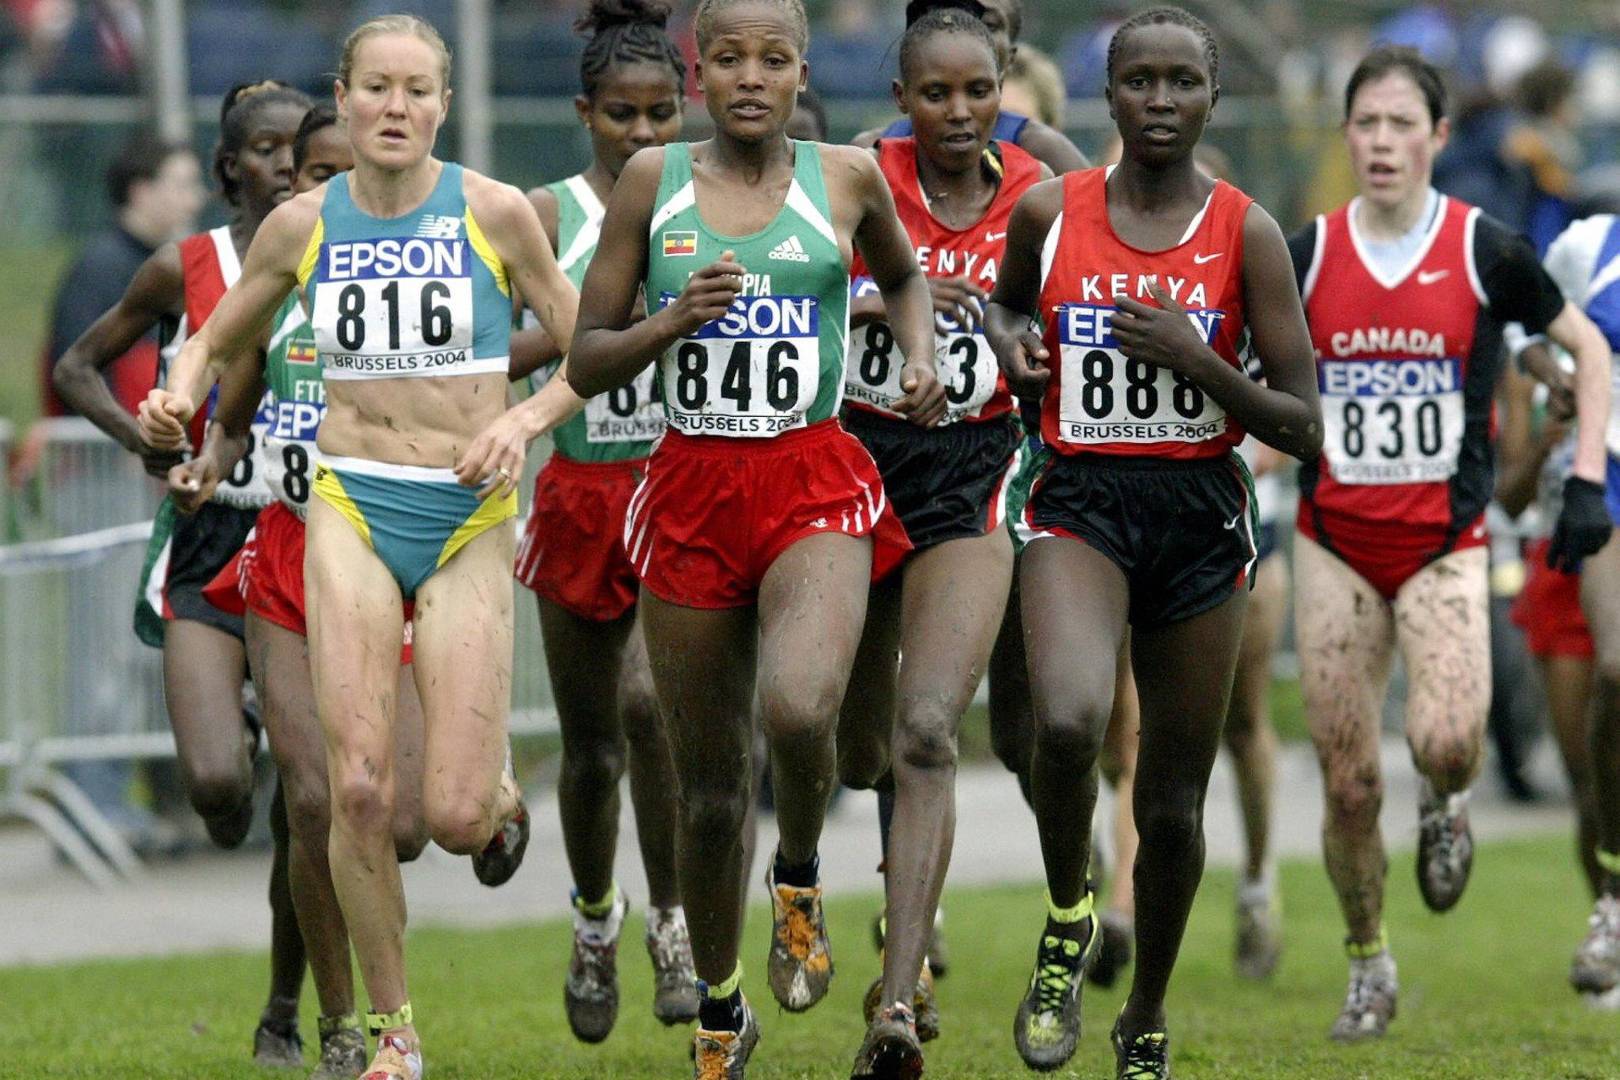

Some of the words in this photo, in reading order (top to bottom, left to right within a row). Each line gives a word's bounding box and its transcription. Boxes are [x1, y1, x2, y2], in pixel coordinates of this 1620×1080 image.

[329, 239, 463, 279] EPSON
[768, 250, 810, 263] adidas
[915, 246, 998, 282] ENYA
[1081, 273, 1207, 308] KENYA
[336, 280, 453, 351] 816
[668, 297, 810, 336] SON
[1068, 306, 1215, 344] EPN
[334, 353, 417, 371] BRUSSELS
[424, 350, 466, 367] 2004
[1331, 327, 1446, 358] CANADA
[677, 340, 799, 412] 846
[860, 321, 979, 405] 83
[1324, 360, 1454, 396] EPSON
[1082, 350, 1204, 419] 888
[1071, 424, 1168, 439] BRUSSELS
[1175, 422, 1217, 439] 2004
[1343, 401, 1442, 459] 830
